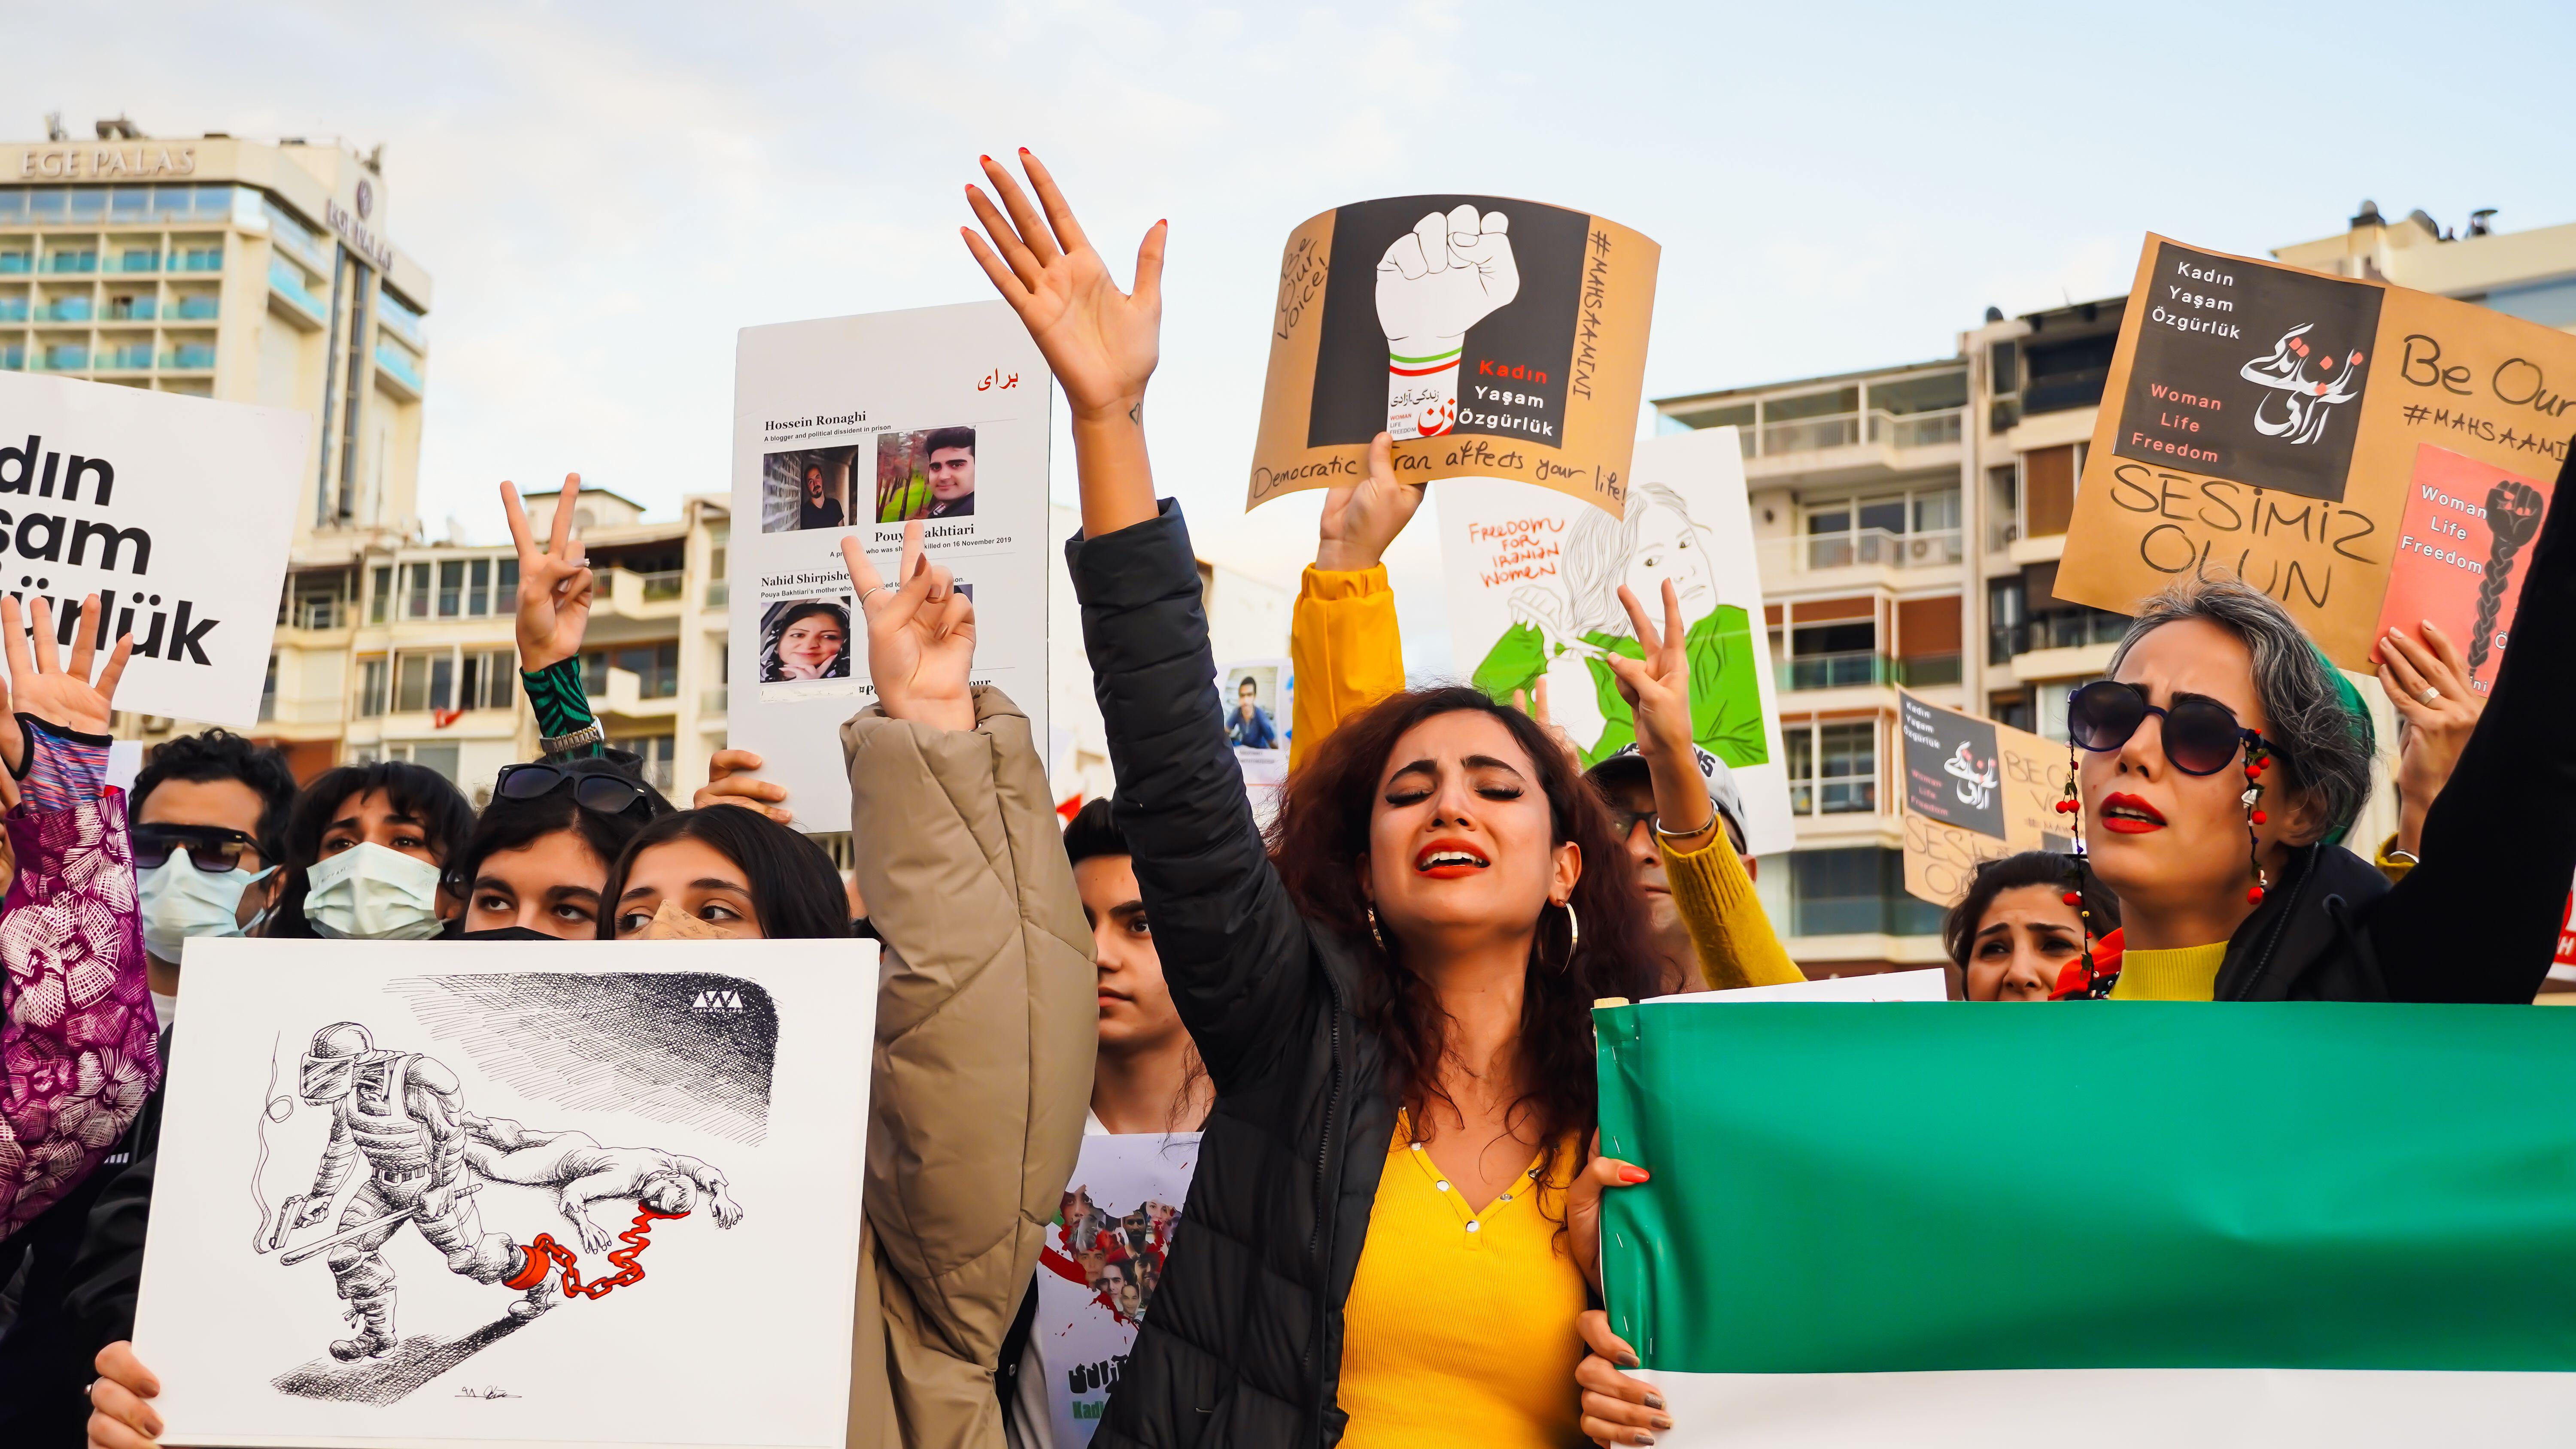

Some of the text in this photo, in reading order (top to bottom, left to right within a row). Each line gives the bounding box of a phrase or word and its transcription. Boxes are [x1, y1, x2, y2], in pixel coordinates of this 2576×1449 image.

[19, 147, 196, 179] EGE PALAS
[2177, 261, 2233, 286] Kadın
[2169, 285, 2233, 312] Yaşam
[1572, 230, 1612, 401] #MAHSAAMINI
[2151, 306, 2241, 340] Özgürlük
[978, 367, 1018, 391] برای
[1479, 360, 1547, 384] Kadın
[2401, 334, 2576, 417] Be Our
[1474, 385, 1544, 409] Yaşam
[2151, 383, 2222, 411] Woman
[765, 411, 866, 431] Hossein Ronaghi
[808, 430, 832, 439] political
[834, 427, 863, 435] dissident
[871, 424, 892, 433] prison
[1458, 408, 1553, 437] Özgürlük
[2160, 412, 2199, 432] Life
[2403, 404, 2567, 462] #MAHSAAMI
[2131, 431, 2219, 463] Freedom
[1253, 440, 1626, 506] Democratic ran affects your life!
[2421, 484, 2488, 520] Woman
[875, 523, 975, 543] Pouy akhtiari
[2430, 515, 2467, 540] Life
[2400, 535, 2482, 575] Freedom
[761, 571, 851, 587] Nahid Shirpishe
